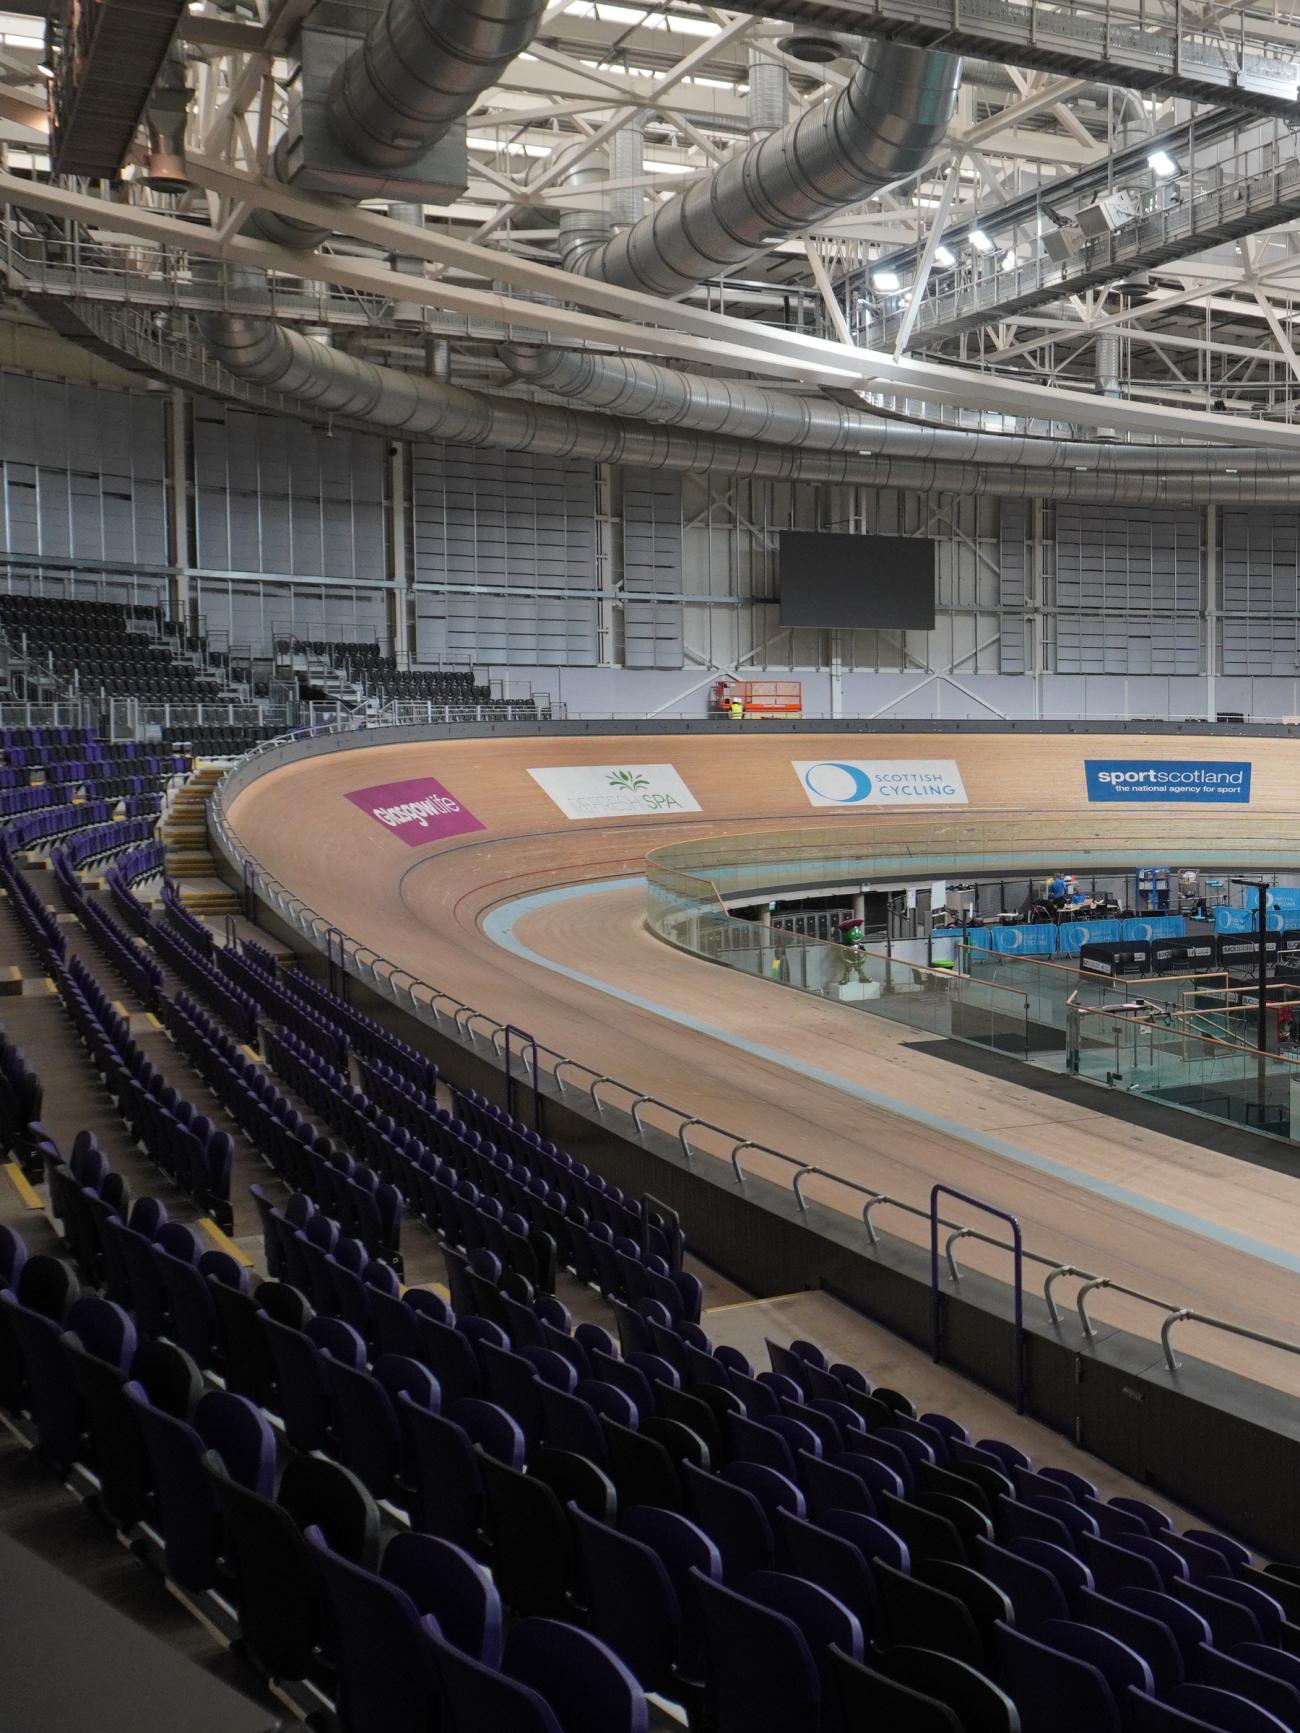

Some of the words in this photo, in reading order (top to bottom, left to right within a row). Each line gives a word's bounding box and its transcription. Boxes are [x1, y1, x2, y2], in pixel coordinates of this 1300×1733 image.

[875, 774, 943, 782] SCOTTISH
[1098, 770, 1243, 785] sportscotland
[879, 785, 956, 796] CYCLING
[1203, 785, 1215, 793] for
[642, 794, 683, 810] SPA
